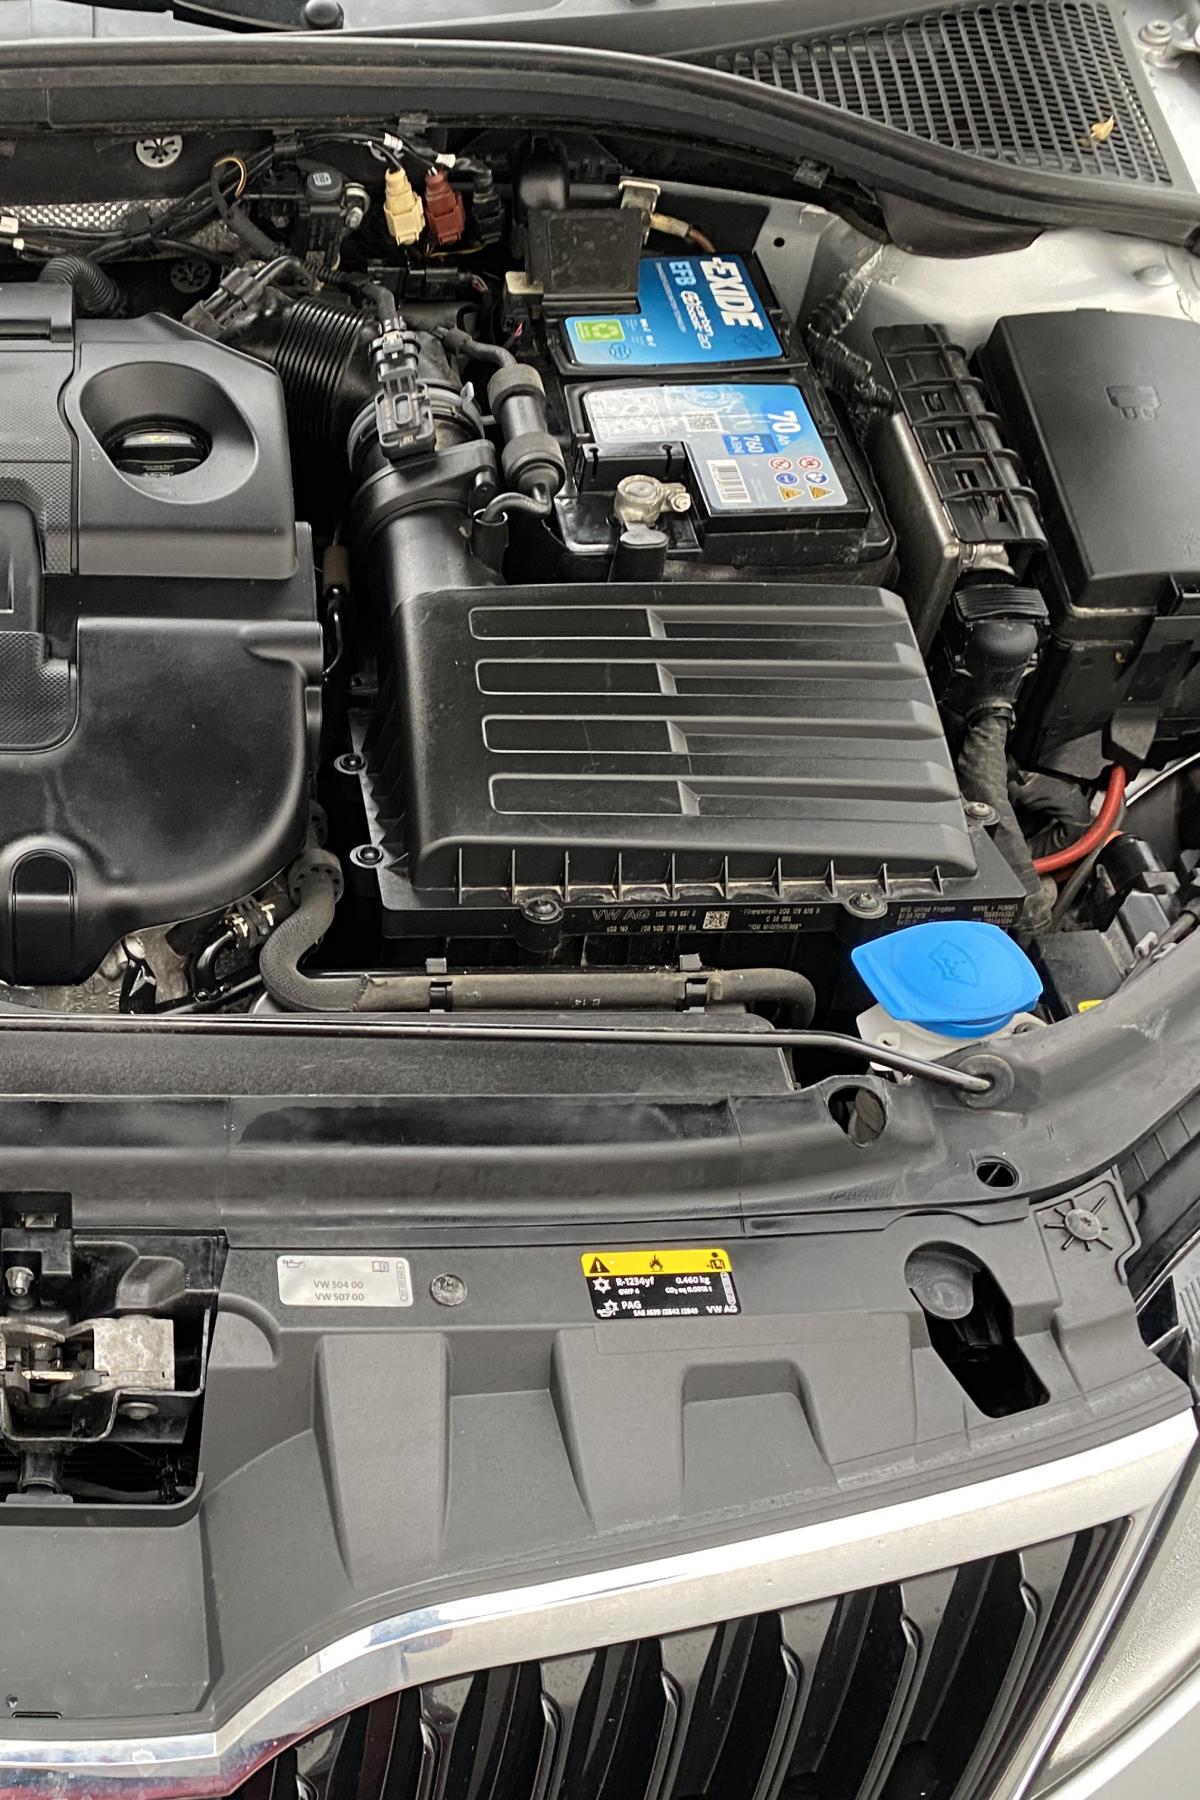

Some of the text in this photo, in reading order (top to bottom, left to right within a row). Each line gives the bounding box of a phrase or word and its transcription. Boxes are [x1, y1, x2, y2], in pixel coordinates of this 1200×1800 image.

[669, 261, 696, 286] EFB
[700, 257, 762, 328] EXIDE
[767, 410, 801, 433] 70
[743, 435, 765, 453] 760
[592, 909, 621, 920] VW
[623, 908, 650, 920] AG
[313, 1281, 364, 1289] VW 504 00
[616, 1276, 654, 1288] R-1234yf
[675, 1275, 711, 1285] 0.460 kg
[315, 1293, 365, 1301] VW 507 00
[621, 1300, 642, 1310] PAG
[706, 1304, 738, 1314] VW AG
